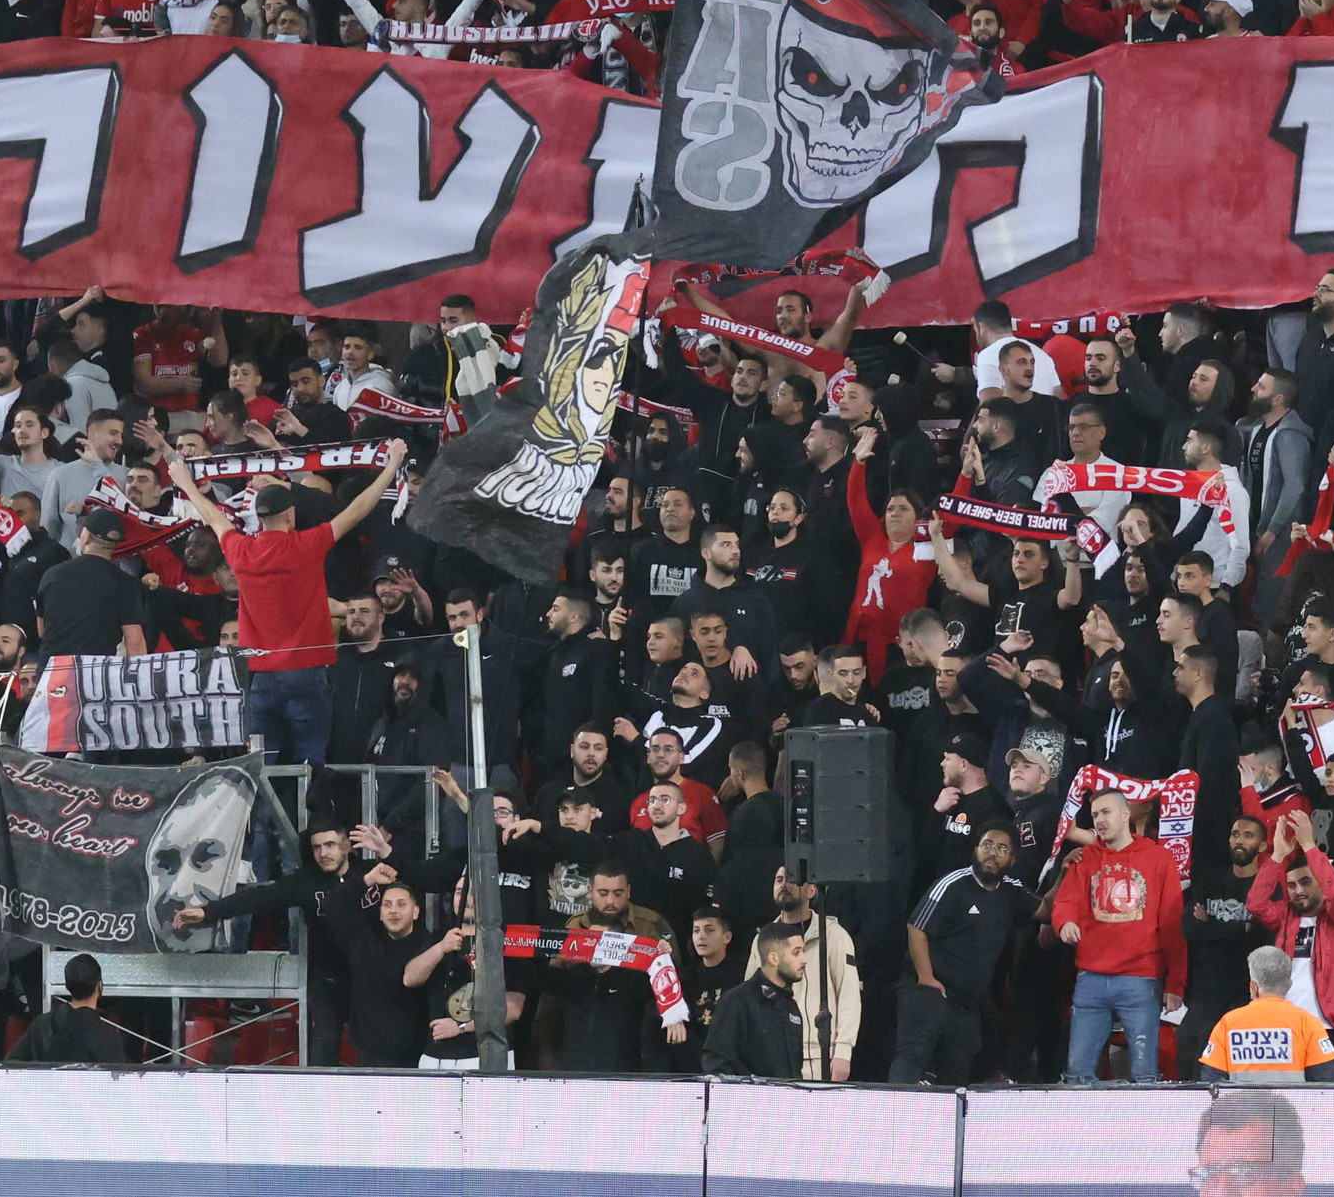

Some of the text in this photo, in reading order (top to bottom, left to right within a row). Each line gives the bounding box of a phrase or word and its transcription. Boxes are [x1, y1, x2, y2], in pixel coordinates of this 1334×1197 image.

[700, 313, 815, 356] EUROPA LEAGUE
[1087, 463, 1186, 492] HBS
[938, 495, 1068, 533] HAPOEL BEER-SHEVA FC
[77, 648, 245, 705] ULTRA
[79, 697, 246, 752] SOUTH
[3, 759, 151, 817] always in
[1161, 788, 1197, 803] באר
[1160, 802, 1195, 818] שבע
[52, 815, 140, 860] heart
[1230, 1030, 1289, 1047] ניצנים
[1230, 1046, 1289, 1061] אבטחה
